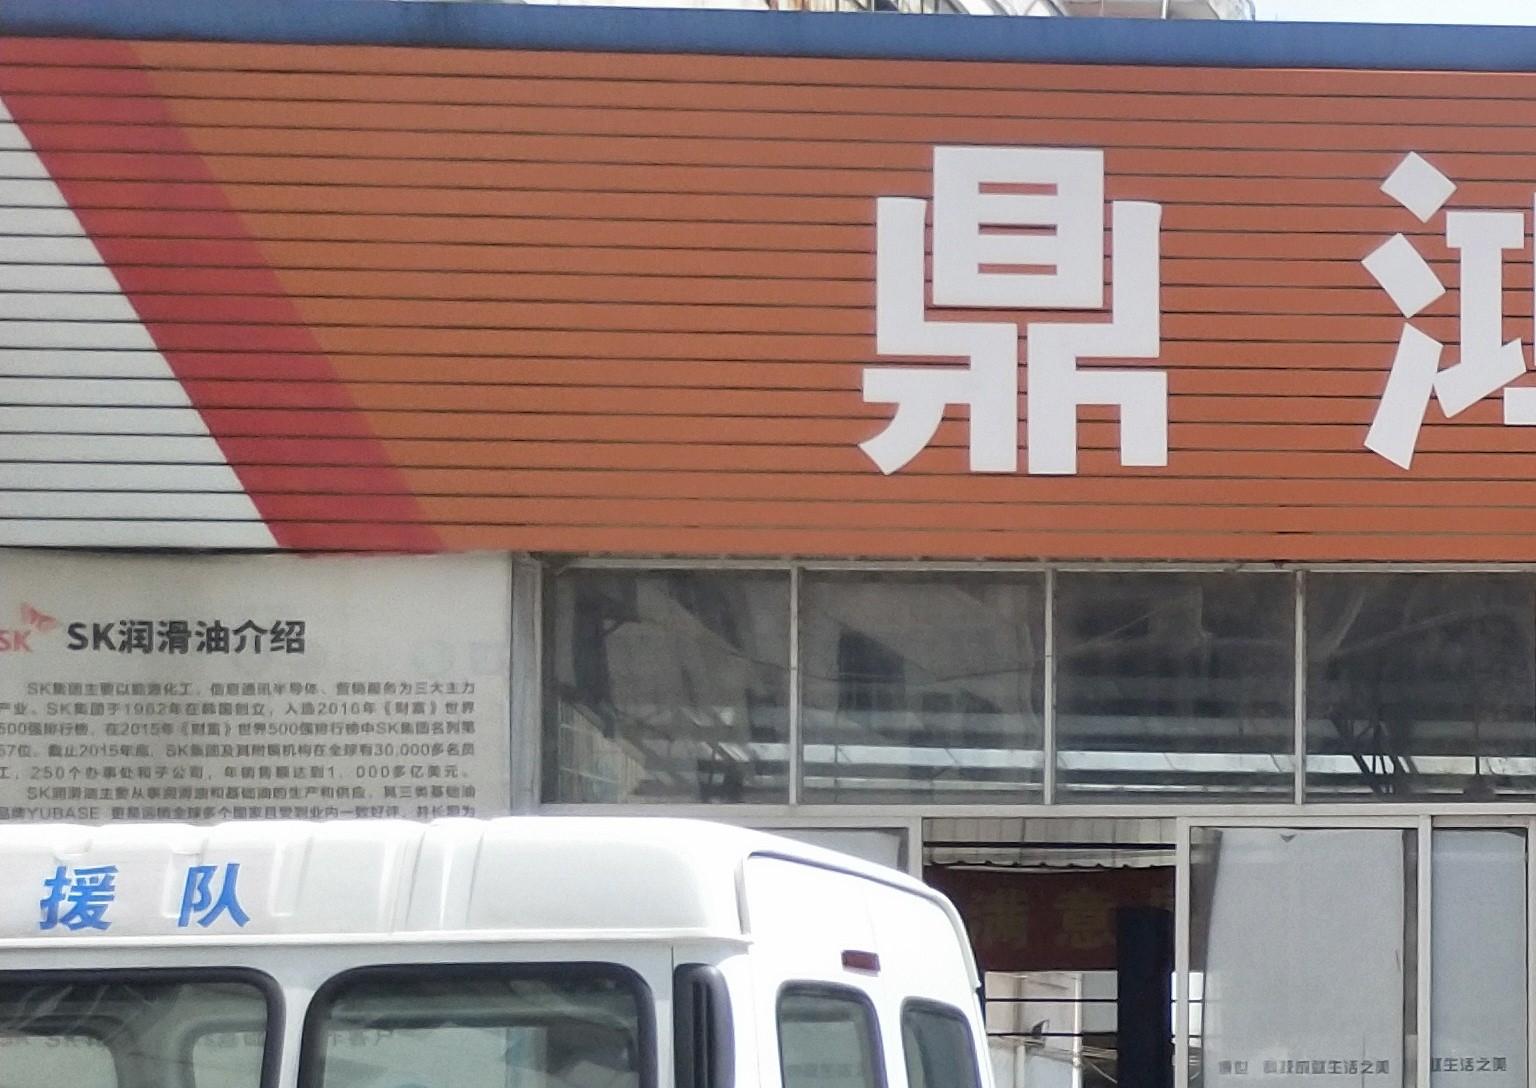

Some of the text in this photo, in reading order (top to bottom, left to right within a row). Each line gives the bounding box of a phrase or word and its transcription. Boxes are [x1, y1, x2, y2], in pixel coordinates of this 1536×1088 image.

[67, 619, 305, 654] SK润滑油介绍
[38, 863, 251, 931] 援队
